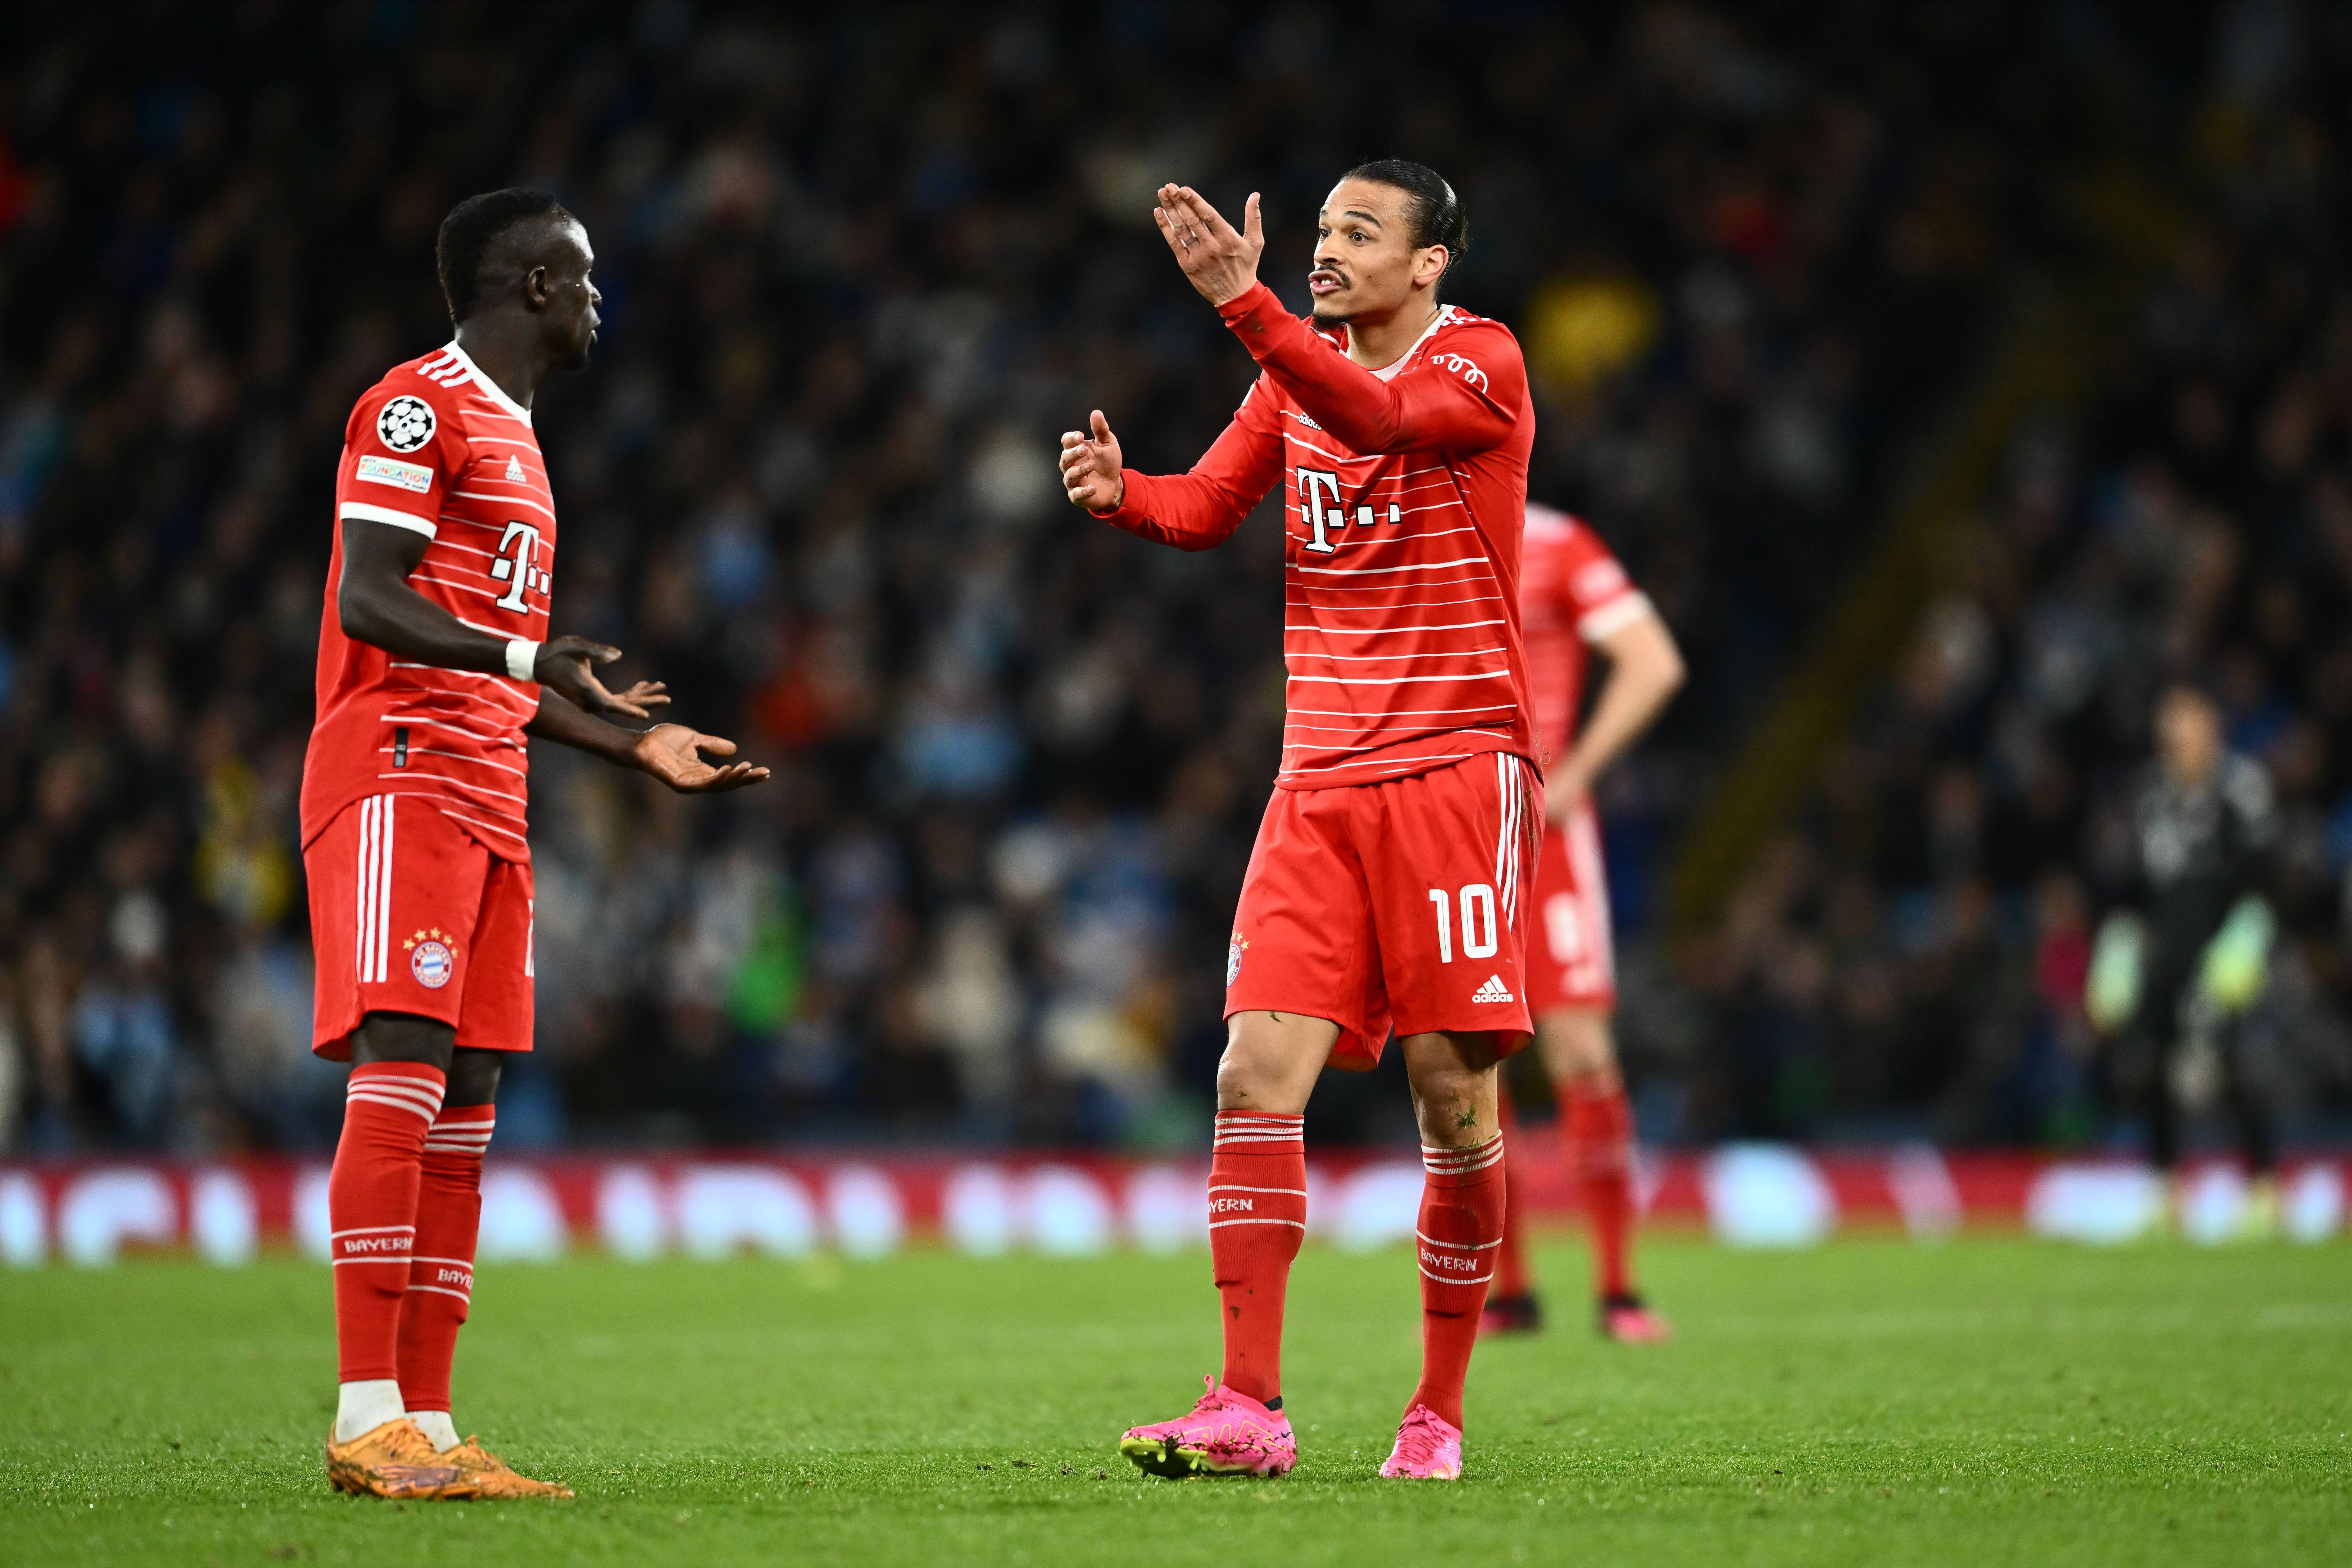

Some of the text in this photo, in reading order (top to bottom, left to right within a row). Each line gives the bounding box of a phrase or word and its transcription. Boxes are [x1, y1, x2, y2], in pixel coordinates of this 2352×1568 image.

[361, 464, 429, 484] FOUNDATION
[1429, 883, 1497, 963] 10
[1472, 992, 1514, 1003] adidas
[1421, 1247, 1477, 1271] BAYERN
